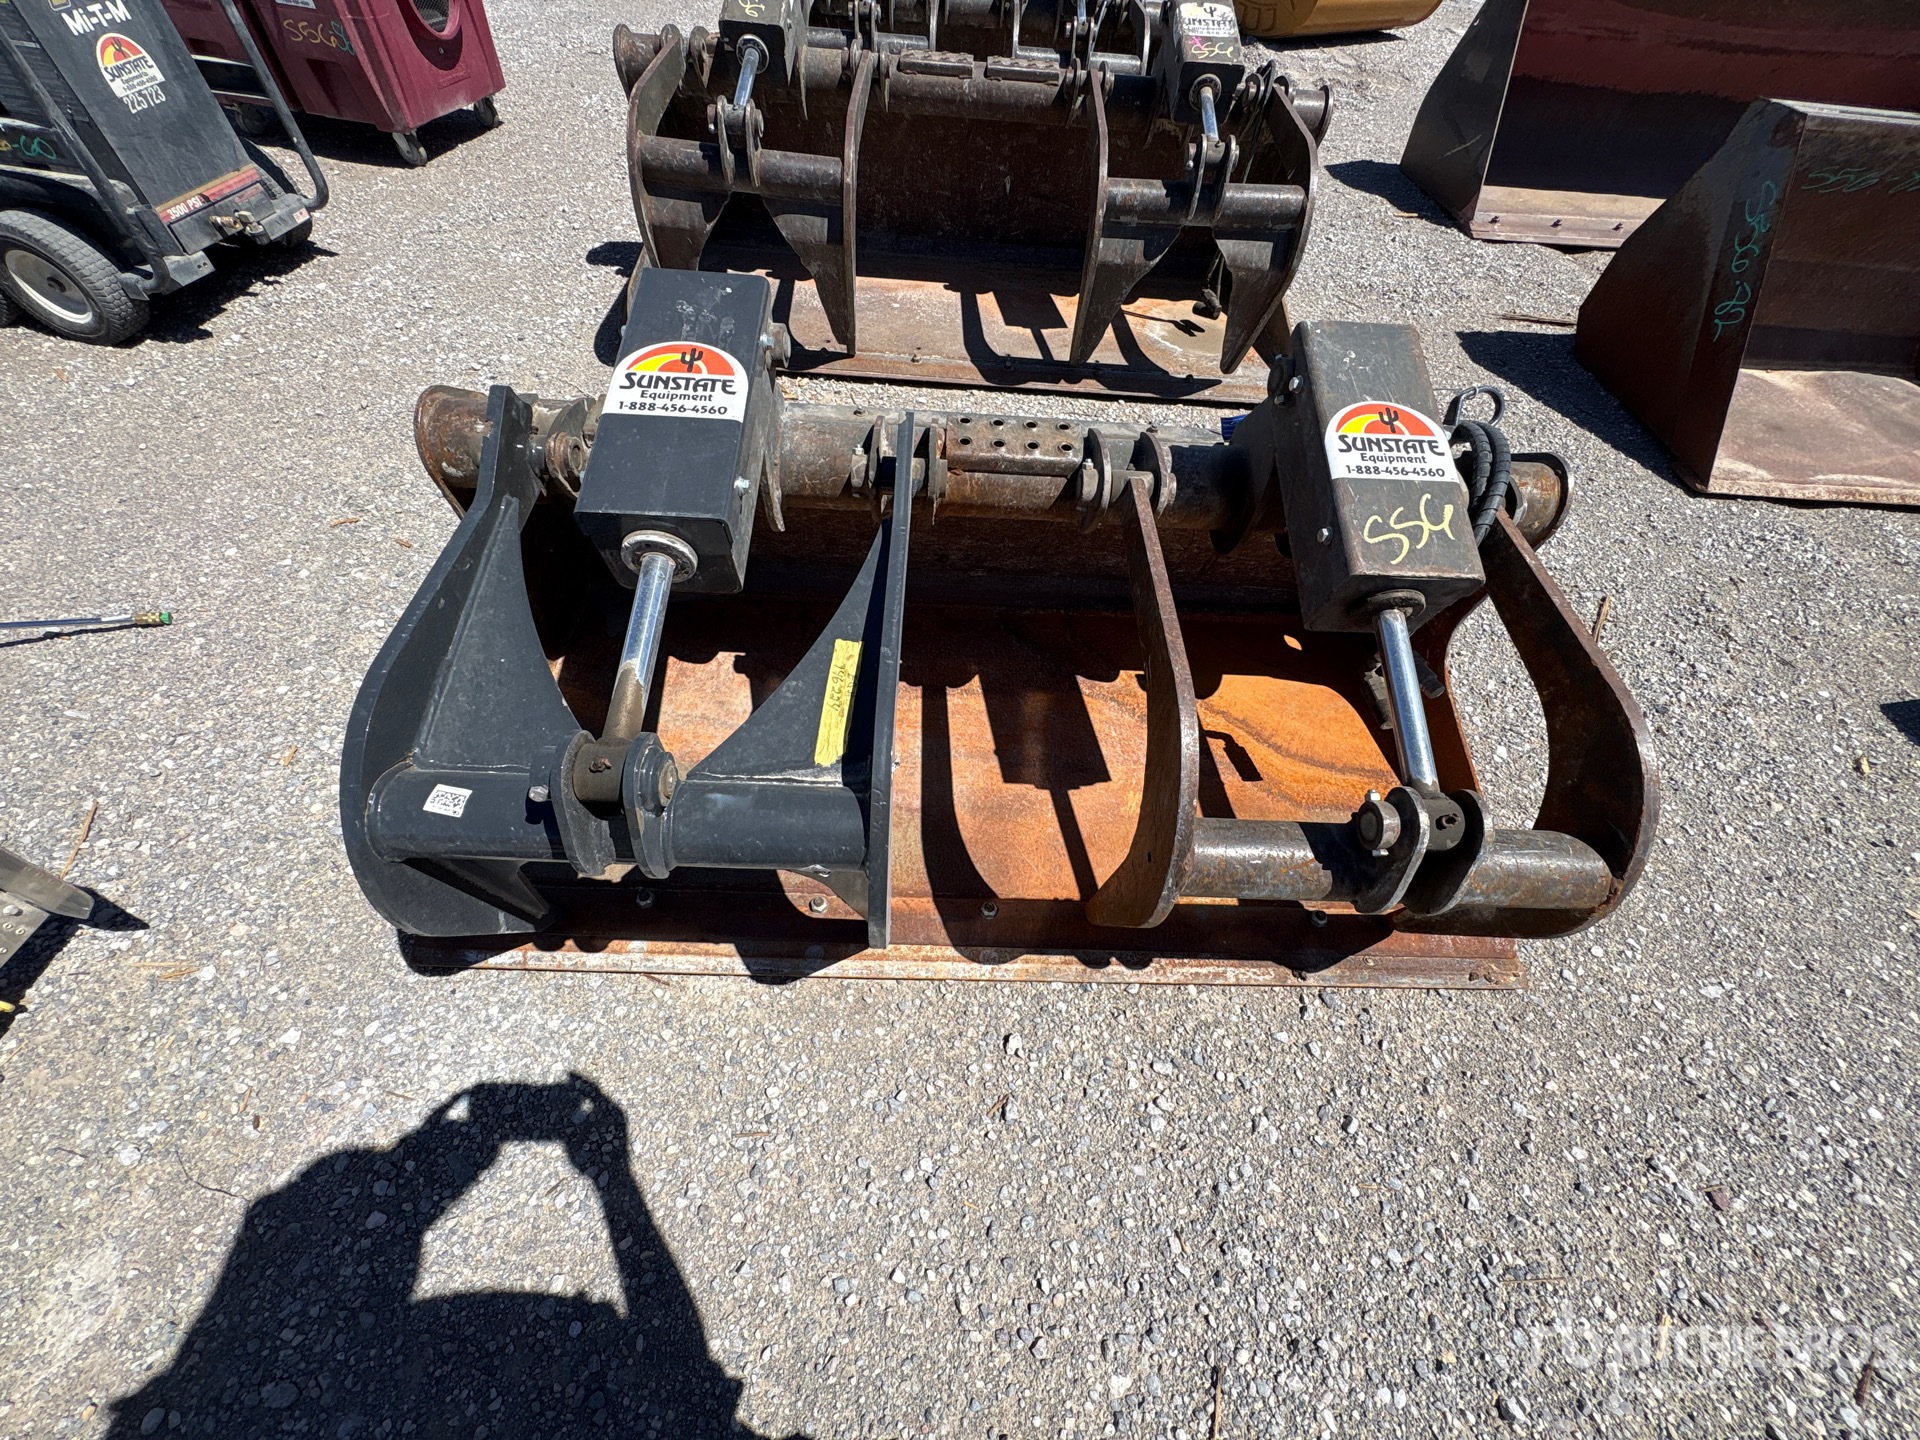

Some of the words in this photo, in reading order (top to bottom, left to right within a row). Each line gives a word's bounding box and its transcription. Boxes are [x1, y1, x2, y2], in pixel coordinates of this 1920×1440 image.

[61, 0, 132, 36] Mi-T-M
[104, 55, 154, 83] SUNSTATE
[123, 85, 166, 114] 225723
[166, 203, 188, 220] 3500
[187, 197, 203, 211] PSI
[619, 372, 737, 395] SUNSTATE
[640, 389, 714, 402] Equipment
[618, 401, 728, 415] 1-888-456-4560
[1338, 434, 1445, 456] SUNSTATE
[1360, 452, 1427, 464] Equipment
[1345, 465, 1446, 478] 1-888-456-4560
